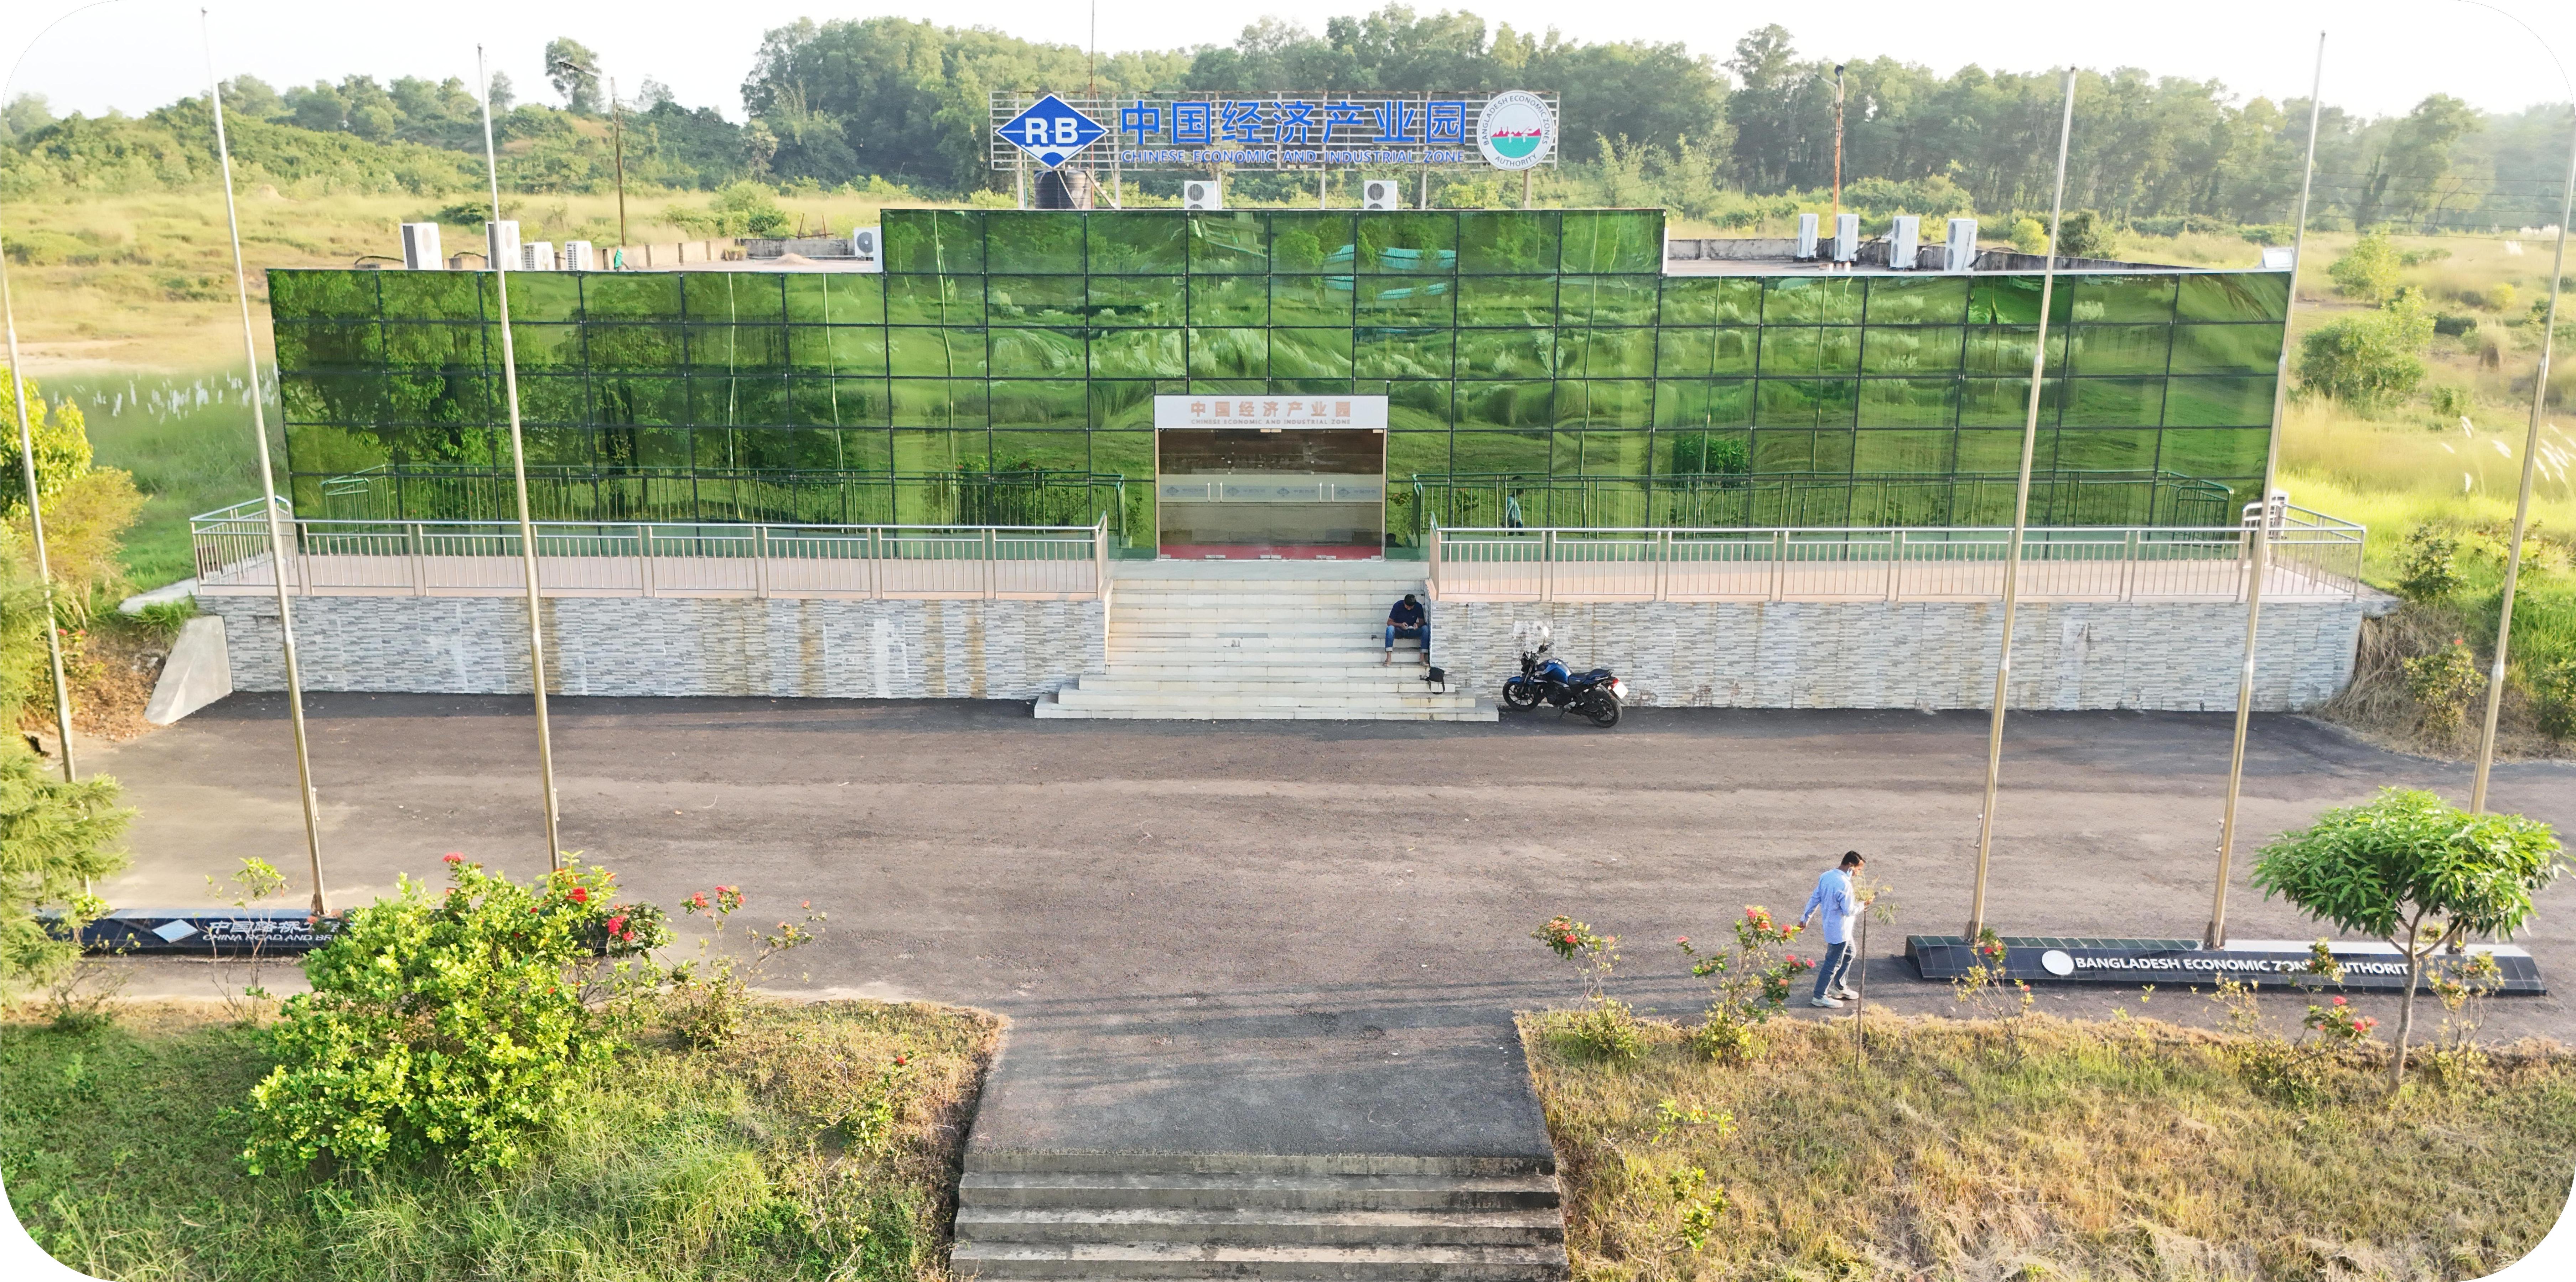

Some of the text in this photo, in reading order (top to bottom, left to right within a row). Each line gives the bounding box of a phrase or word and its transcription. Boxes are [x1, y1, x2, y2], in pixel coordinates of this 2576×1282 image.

[1121, 100, 1466, 145] 中国经济产业园
[1482, 98, 1508, 145] BANGLADESH
[1509, 95, 1546, 117] ECONOMIC
[1122, 150, 1463, 163] CHINESE ECONOMIC AND INDUSTRIAL ZONE
[1495, 153, 1536, 167] AUTHORITY
[1191, 401, 1350, 417] 中国经济产业园
[2075, 957, 2412, 974] BANGLADESH ECONOMIC ZON UTHORIT
